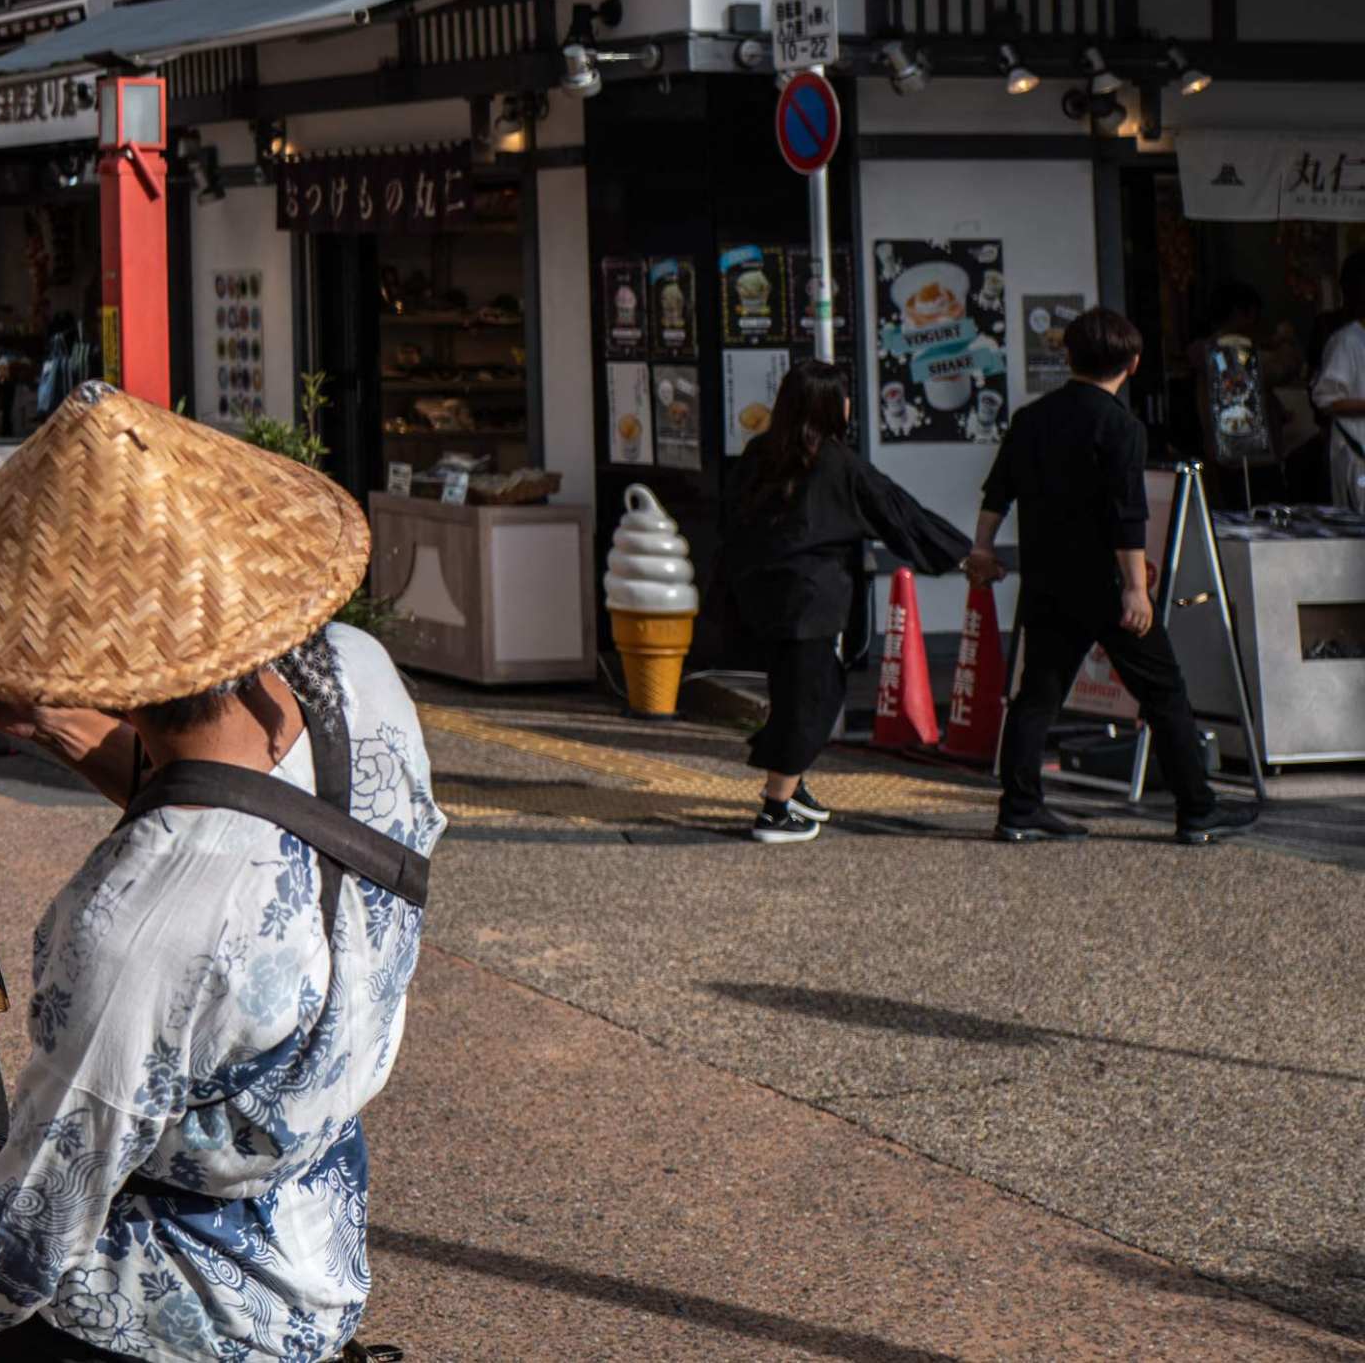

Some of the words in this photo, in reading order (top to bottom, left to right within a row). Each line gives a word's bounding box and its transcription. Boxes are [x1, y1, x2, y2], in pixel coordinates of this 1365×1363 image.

[780, 36, 828, 62] 10-22
[905, 324, 962, 350] YOGURT
[927, 355, 974, 377] SHAKE
